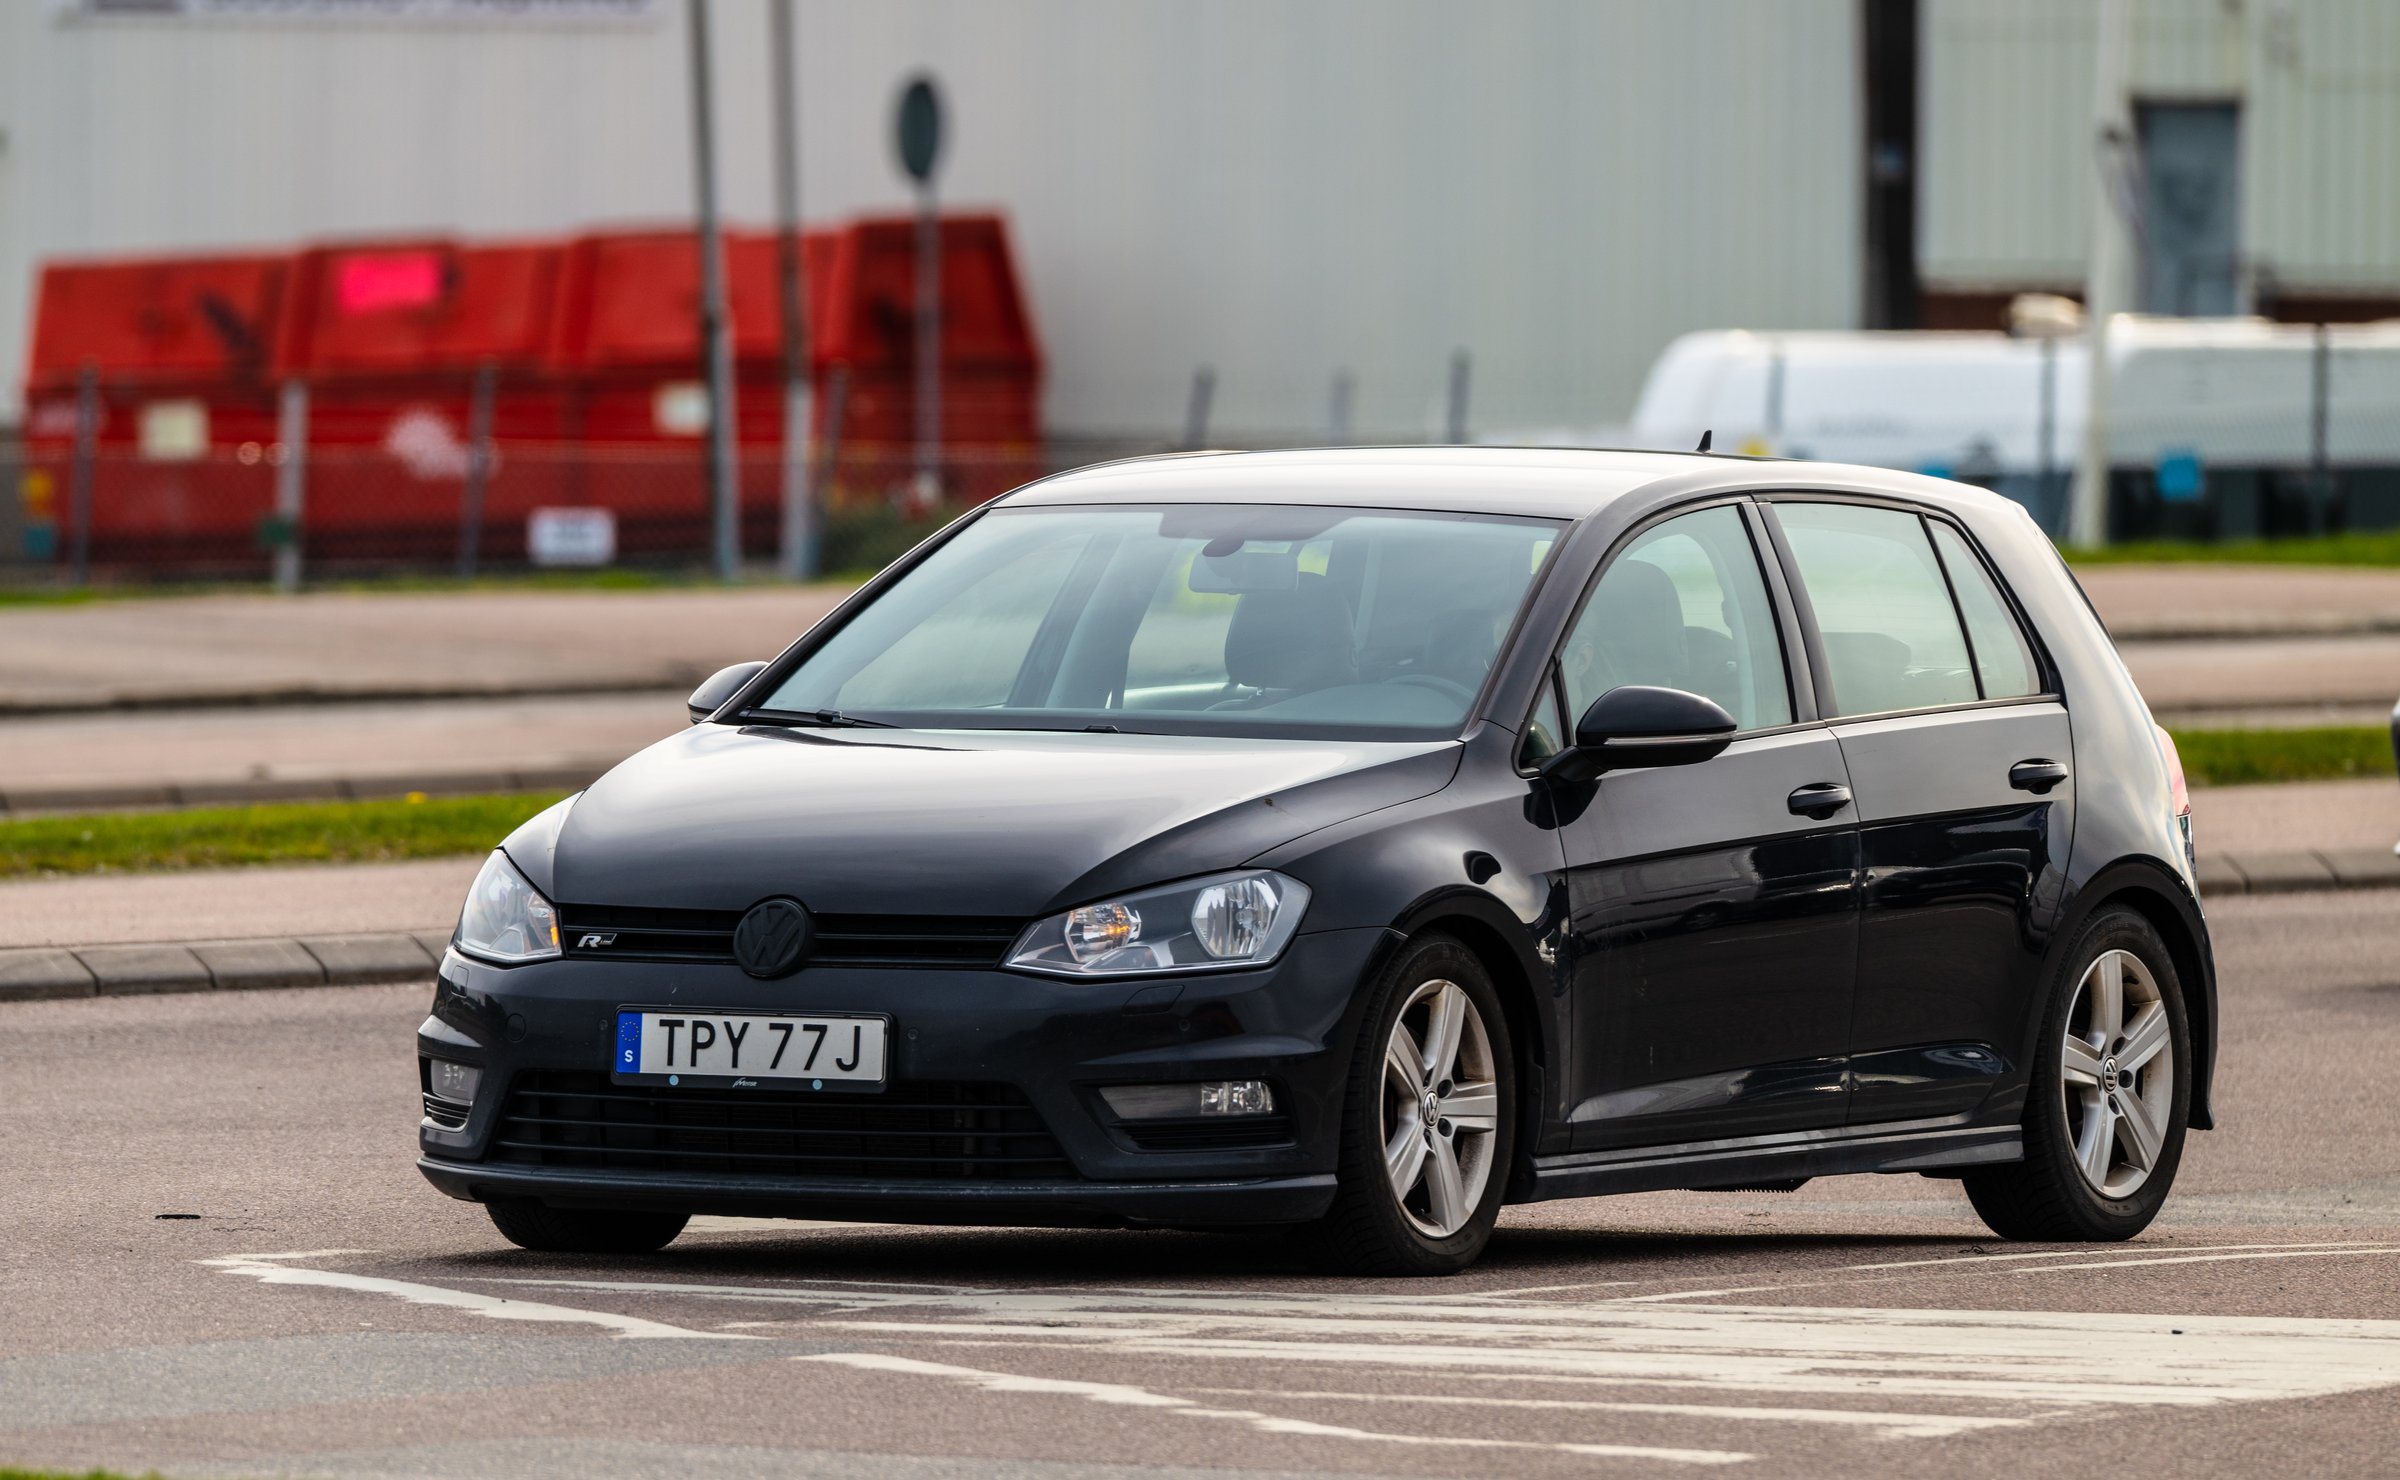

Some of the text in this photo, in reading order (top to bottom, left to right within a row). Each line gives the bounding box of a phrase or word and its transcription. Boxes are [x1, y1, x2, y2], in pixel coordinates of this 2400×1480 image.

[577, 935, 601, 948] R
[659, 1018, 861, 1072] TPY 77J
[624, 1050, 634, 1062] S
